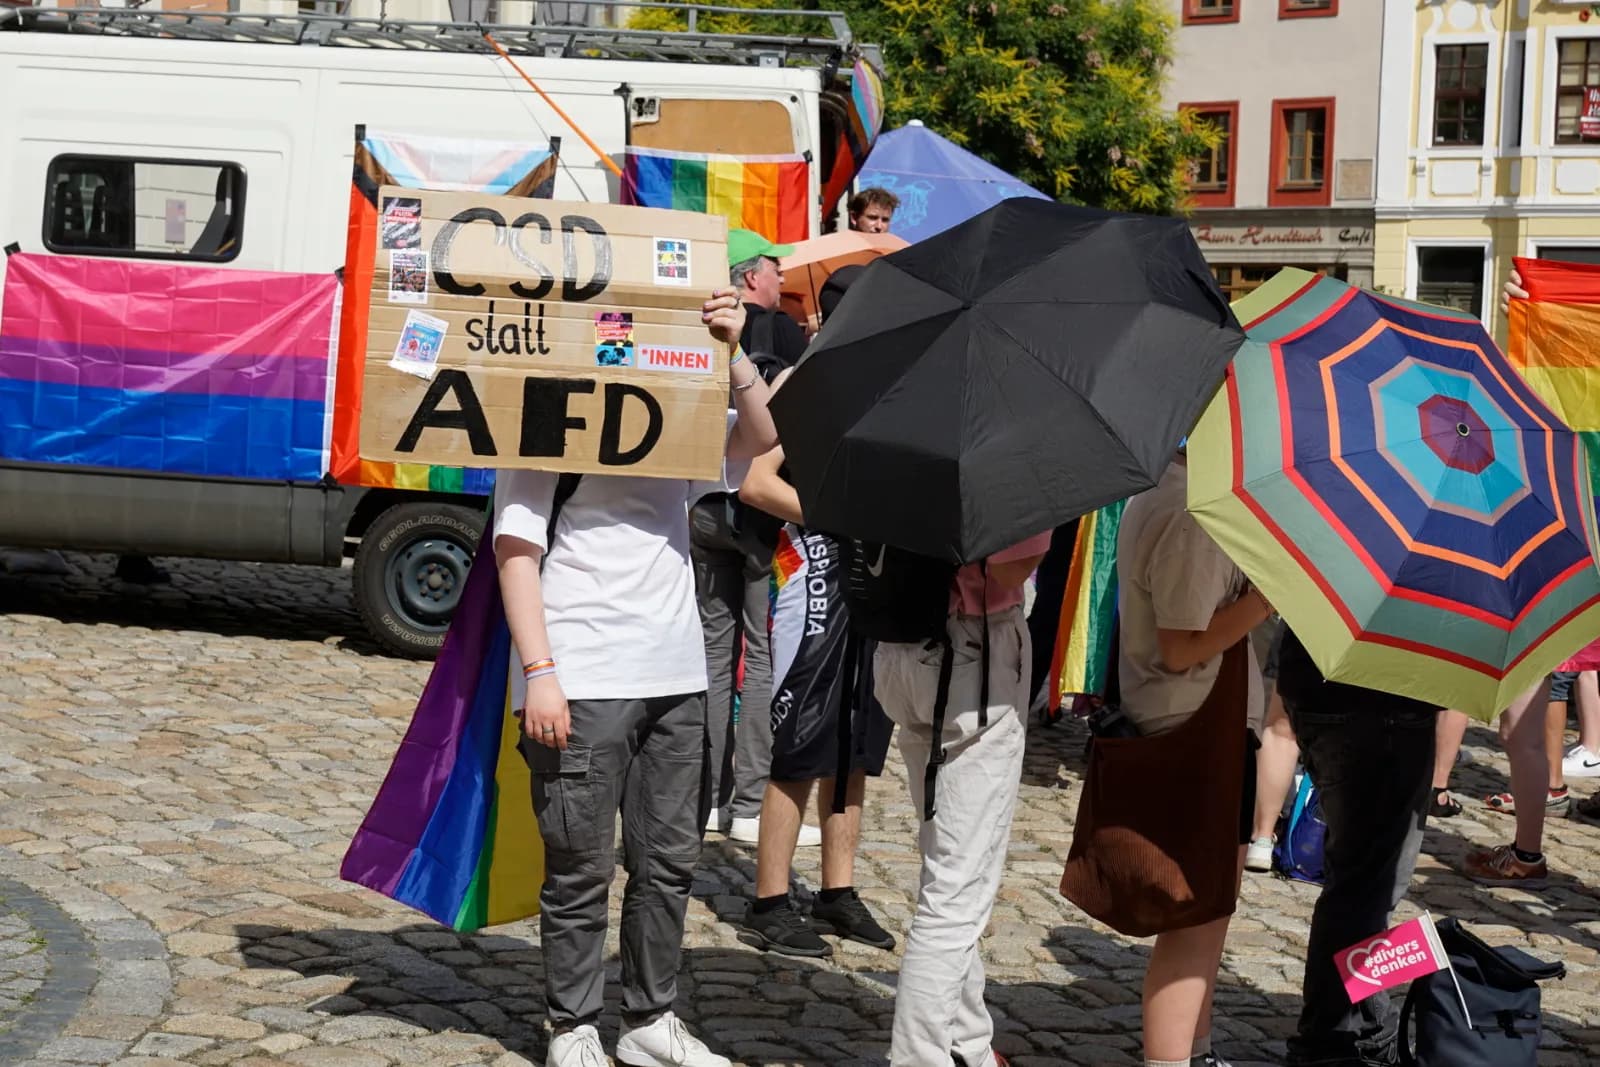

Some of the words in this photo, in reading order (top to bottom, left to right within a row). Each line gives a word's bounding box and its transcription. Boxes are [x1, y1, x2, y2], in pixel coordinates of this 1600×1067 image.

[431, 207, 613, 301] CSD
[465, 301, 550, 355] statt
[1364, 940, 1419, 968] #divers
[1371, 951, 1427, 978] denken
